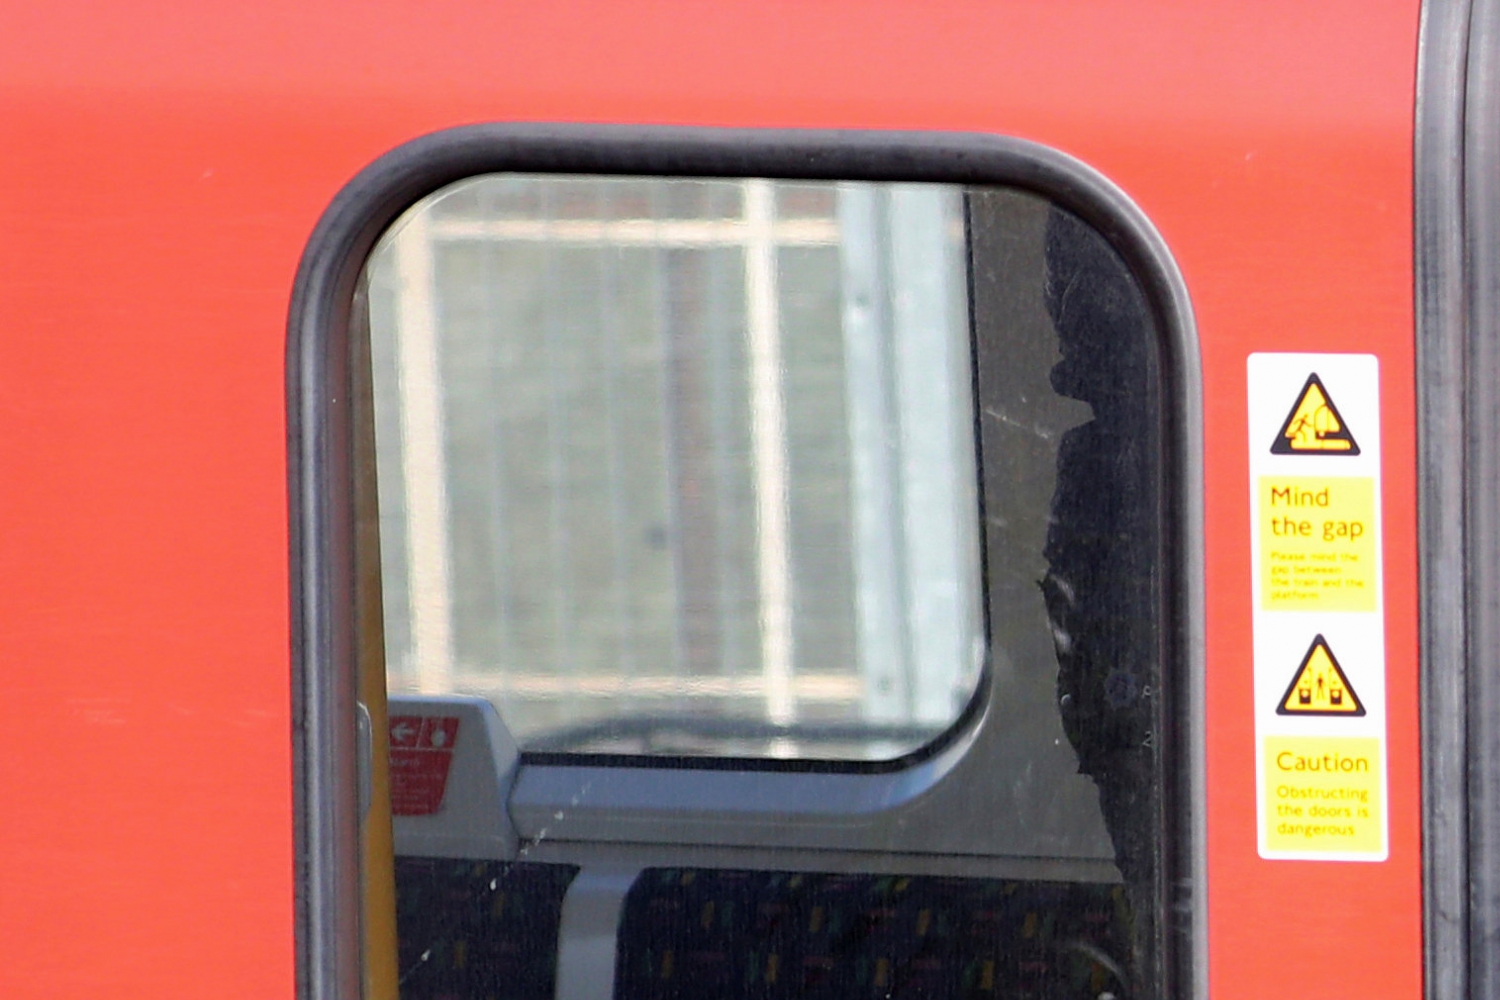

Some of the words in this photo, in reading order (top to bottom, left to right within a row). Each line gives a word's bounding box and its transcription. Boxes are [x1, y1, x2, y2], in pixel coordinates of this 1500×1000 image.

[1271, 486, 1329, 507] Mind
[1271, 516, 1312, 536] the
[1322, 521, 1364, 542] gap
[1276, 751, 1369, 772] Caution
[1276, 785, 1368, 803] Obstructing
[1277, 804, 1303, 818] the
[1308, 805, 1352, 818] doors
[1357, 806, 1369, 818] is
[1277, 822, 1355, 838] dangerous
